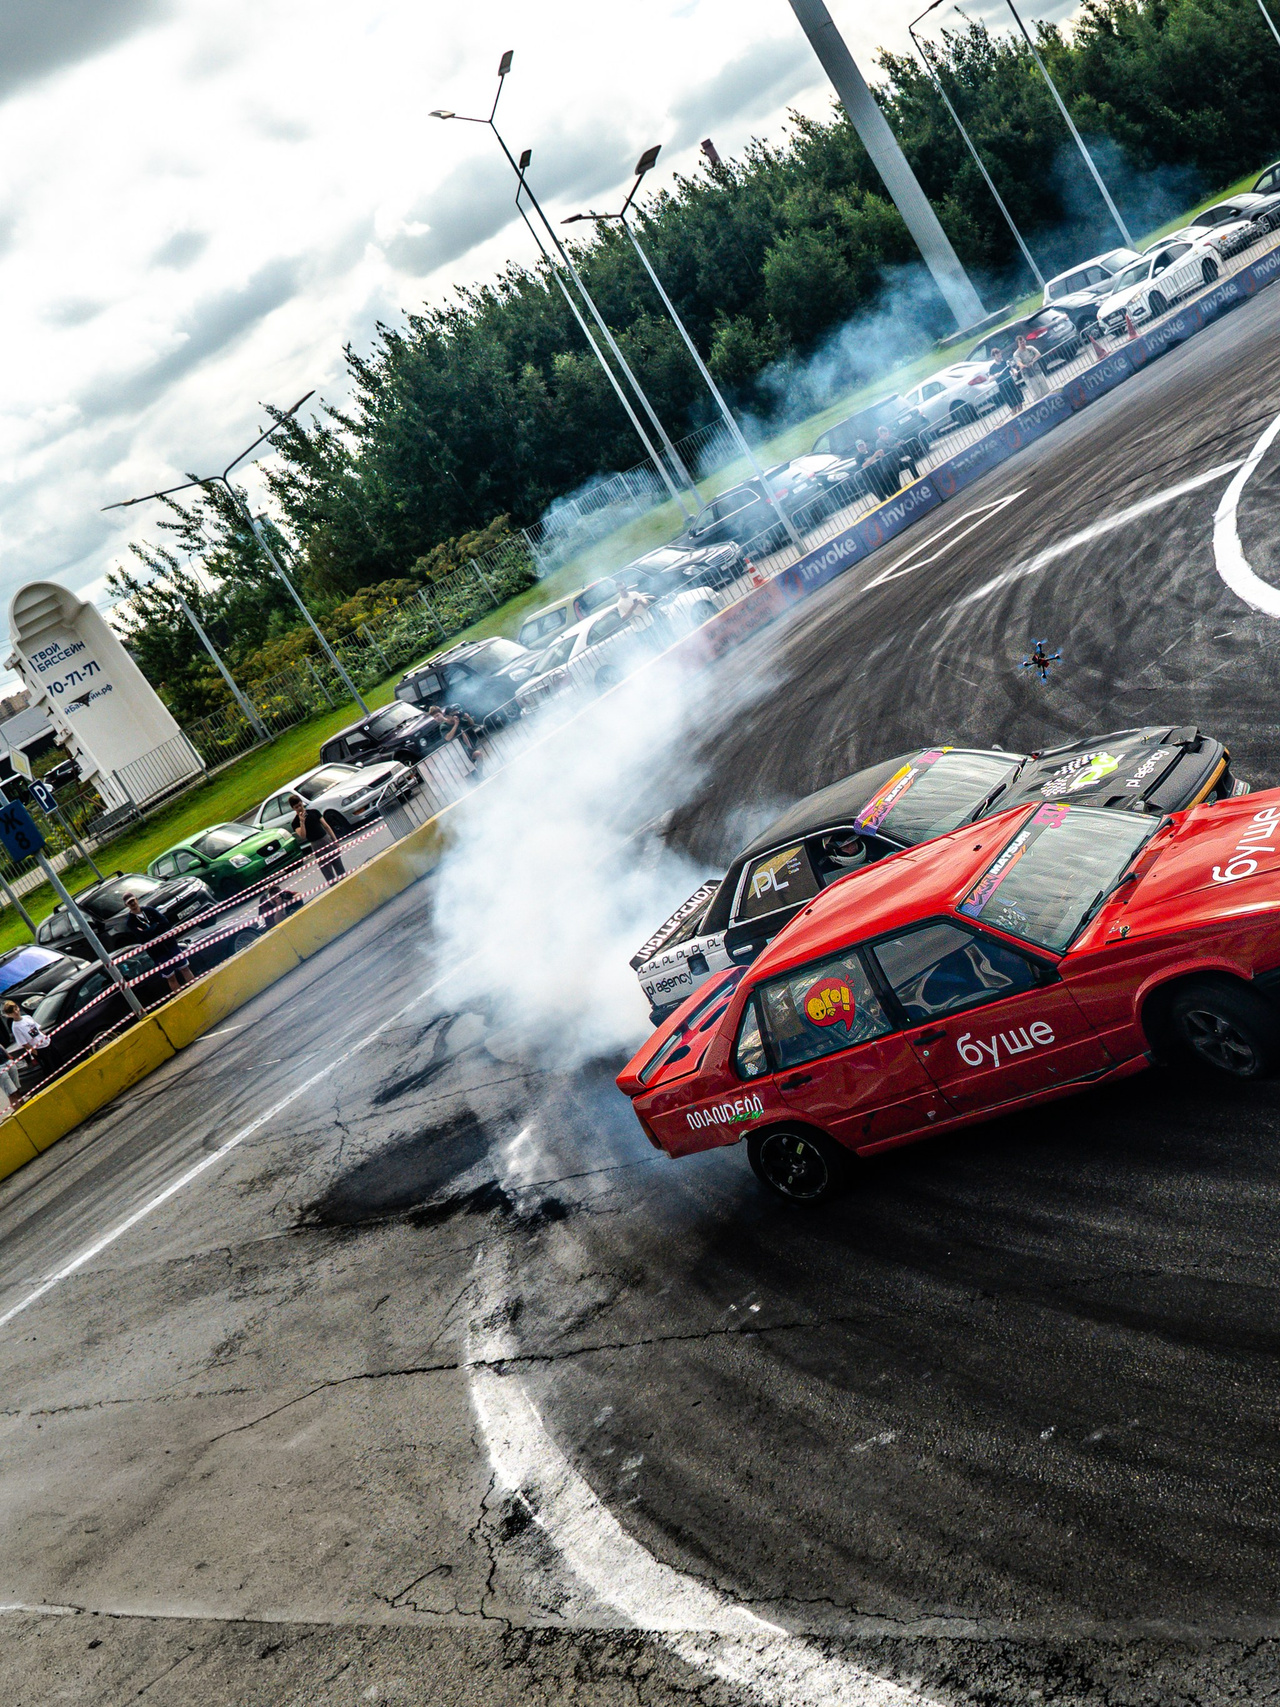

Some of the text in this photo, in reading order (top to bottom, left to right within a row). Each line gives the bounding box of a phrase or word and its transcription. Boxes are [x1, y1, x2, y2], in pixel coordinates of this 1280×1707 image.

[1199, 282, 1238, 314] invoke
[1143, 317, 1185, 352] invoke
[1081, 356, 1128, 391] invoke
[1017, 394, 1066, 432] invoke
[878, 485, 932, 528] invoke
[801, 537, 857, 581] invoke
[31, 642, 61, 663] ТВОЙ
[36, 640, 86, 673] БАССЕЙН
[1134, 749, 1170, 779] agency
[0, 808, 24, 835] Ж
[15, 831, 31, 850] 8
[988, 830, 1031, 875] MATSURI
[752, 867, 790, 899] PL
[661, 956, 674, 966] PL
[676, 949, 689, 960] PL
[690, 943, 704, 955] PL
[706, 938, 721, 950] PL
[655, 971, 694, 993] agency
[956, 1021, 1055, 1068] буше
